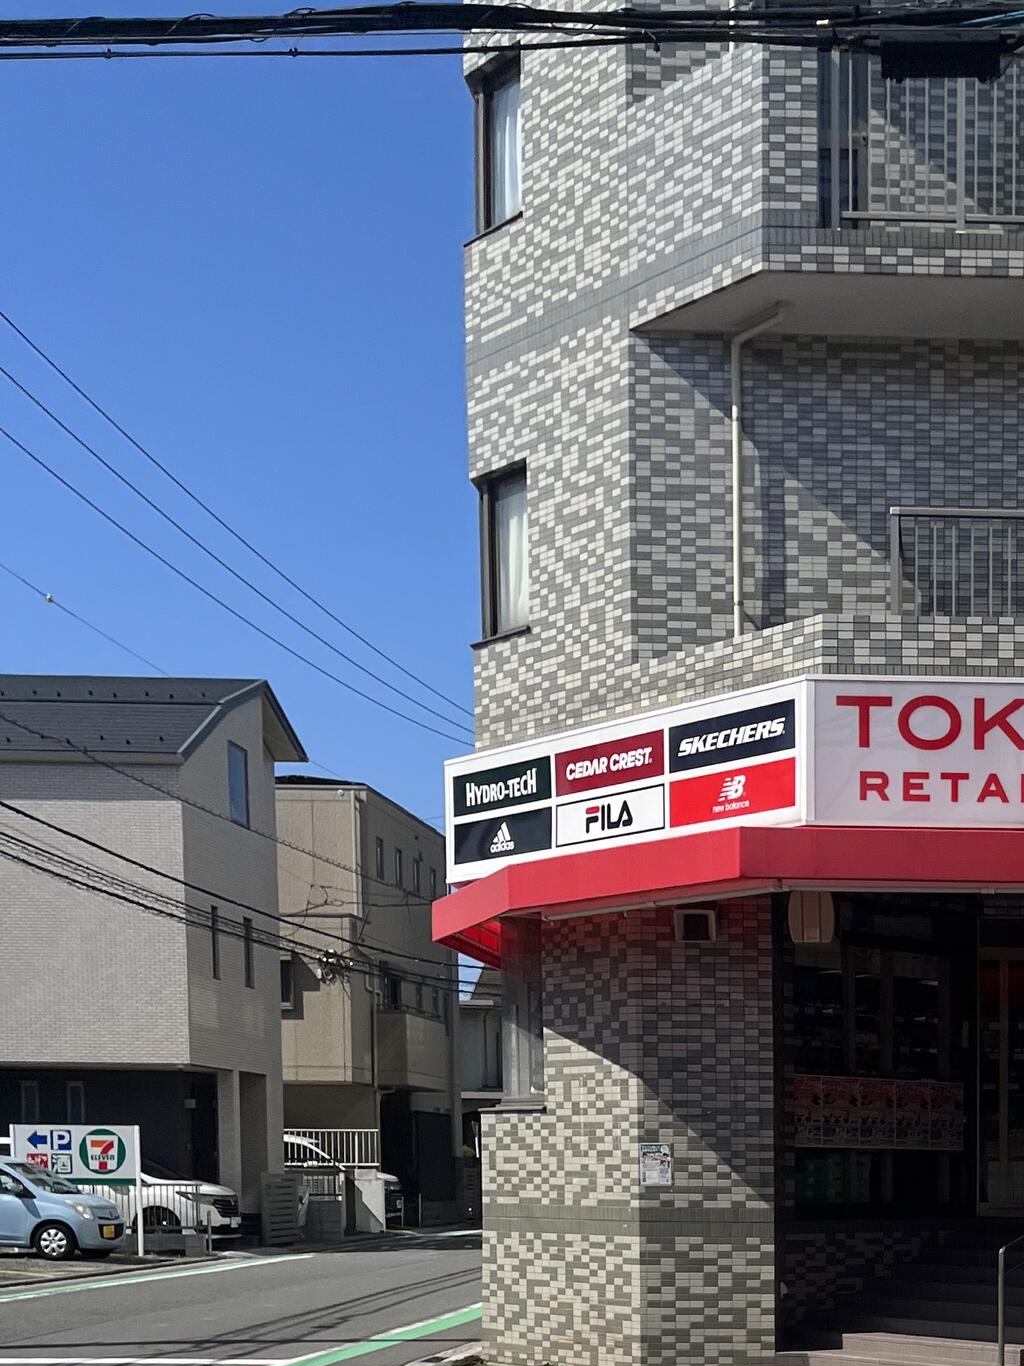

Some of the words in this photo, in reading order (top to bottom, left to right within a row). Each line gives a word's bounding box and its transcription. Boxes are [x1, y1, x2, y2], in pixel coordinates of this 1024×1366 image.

[678, 717, 786, 757] SKECHERS
[566, 757, 608, 781] CEDAR
[609, 747, 653, 771] CREST
[585, 800, 634, 834] FILA
[712, 806, 725, 814] new
[725, 800, 751, 811] balance
[490, 841, 515, 853] adidas
[53, 1131, 70, 1150] P
